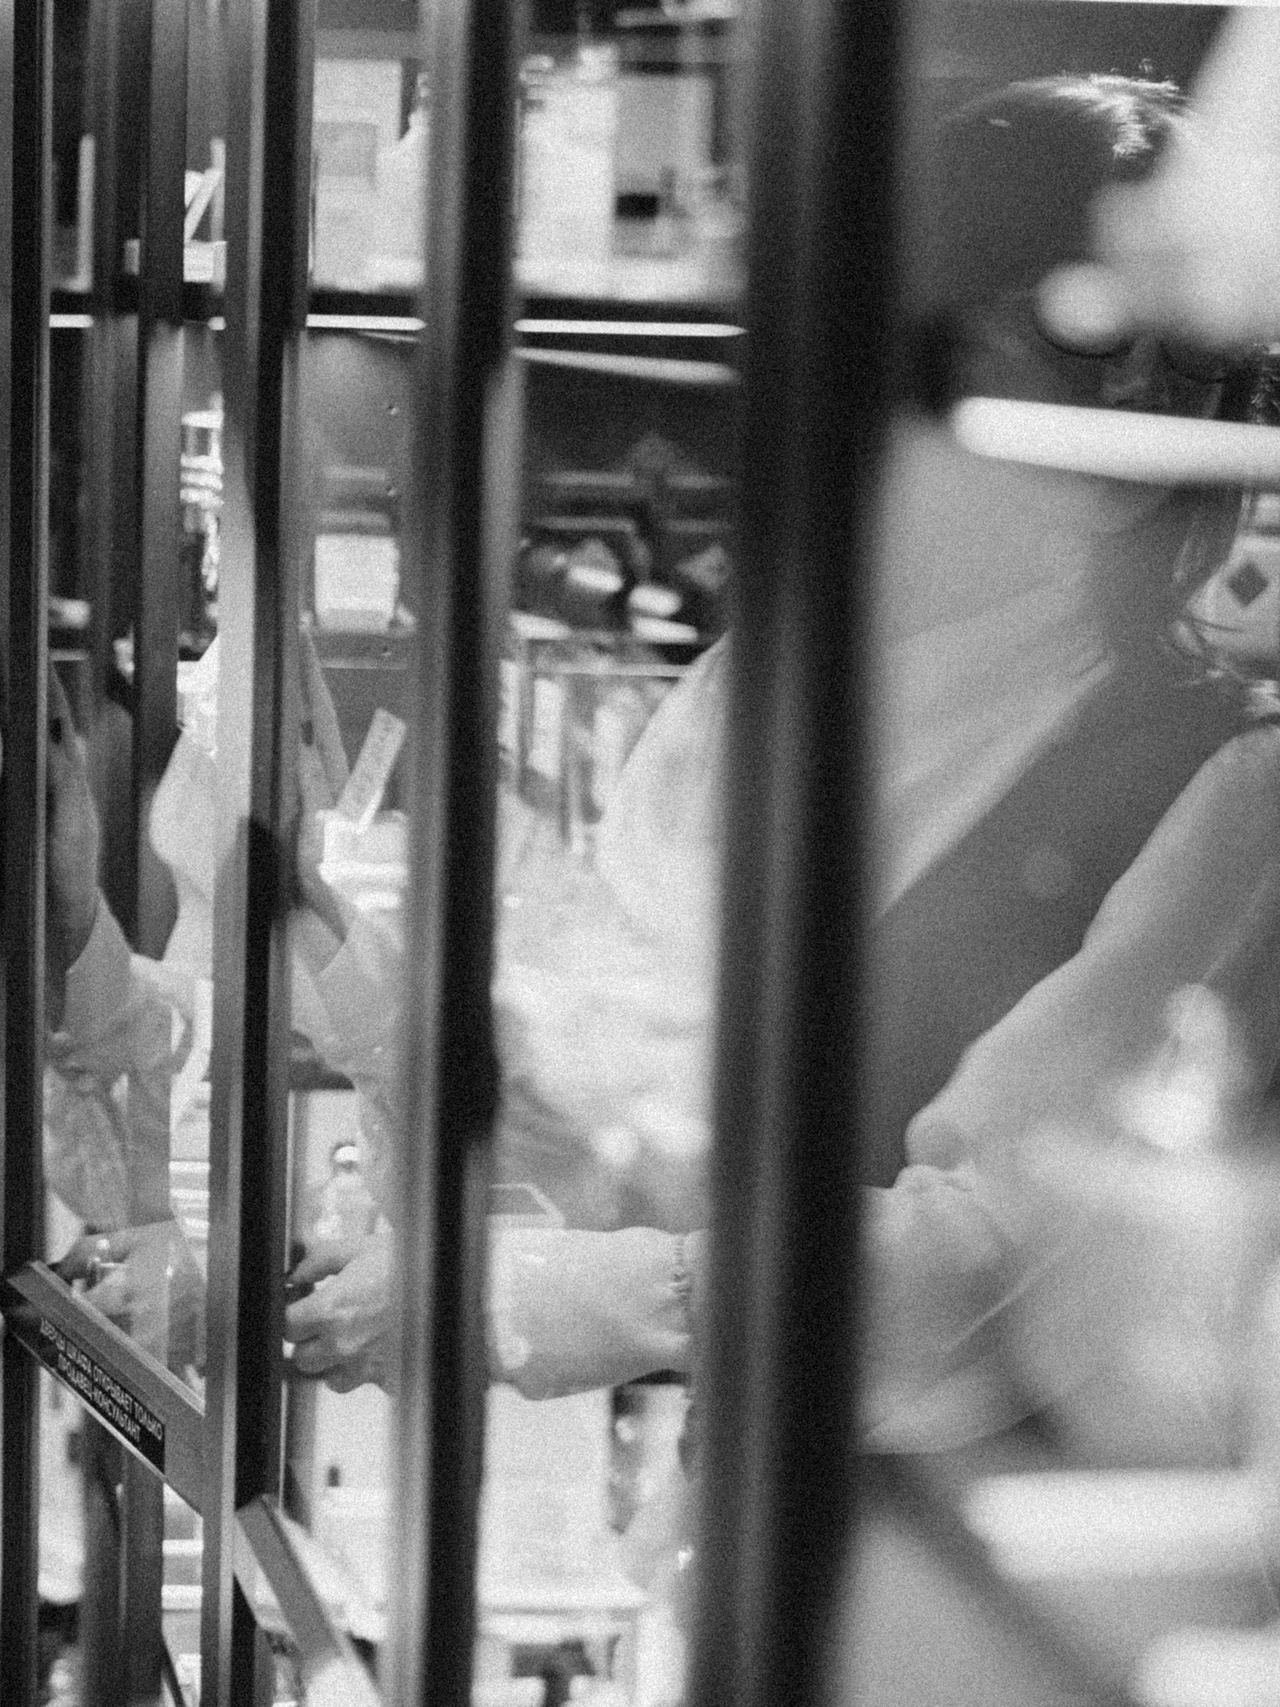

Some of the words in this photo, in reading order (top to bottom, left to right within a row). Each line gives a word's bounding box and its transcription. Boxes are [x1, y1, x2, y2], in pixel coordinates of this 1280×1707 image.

[58, 1352, 141, 1442] ПРОДАВЕЦ-КОНСУЛЬТАНТ
[67, 1343, 92, 1374] ШКАФА
[93, 1364, 133, 1413] ОТКРЫВАЕТ
[134, 1401, 163, 1440] ТОЛЬКО
